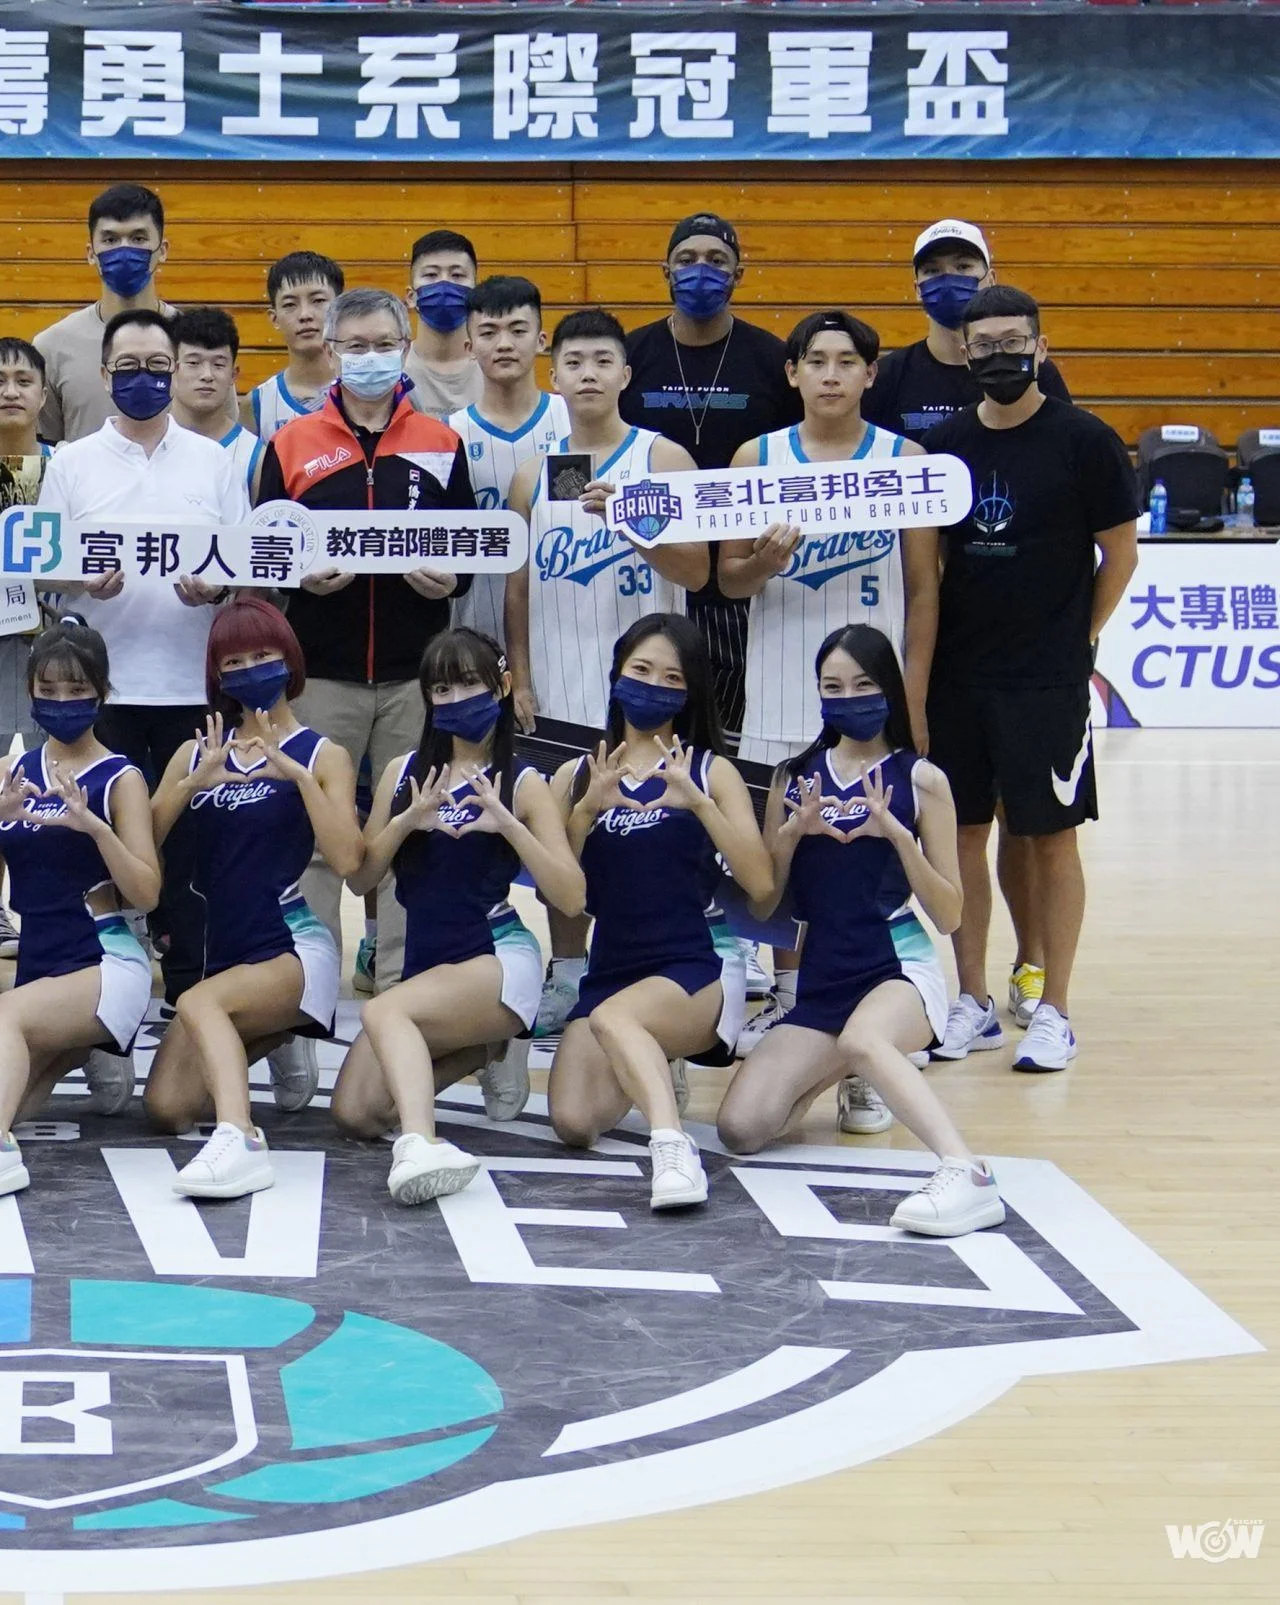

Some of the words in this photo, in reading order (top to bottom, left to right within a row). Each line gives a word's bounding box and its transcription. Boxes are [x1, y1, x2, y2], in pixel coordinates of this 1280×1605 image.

[304, 446, 352, 477] FILA
[694, 467, 947, 509] 臺北富邦勇士
[615, 495, 681, 521] BRAVES
[696, 511, 769, 529] TAIPEI
[787, 506, 852, 523] FUBON
[870, 499, 948, 518] BRAVES
[80, 530, 294, 581] 富邦人壽
[326, 526, 511, 558] 教育部體育署
[775, 529, 895, 578] raves
[619, 565, 652, 597] 33
[861, 575, 879, 607] 5
[1130, 585, 1279, 630] 大專體
[1131, 645, 1280, 689] CTUS
[190, 782, 271, 811] Angels
[589, 807, 663, 836] Angels
